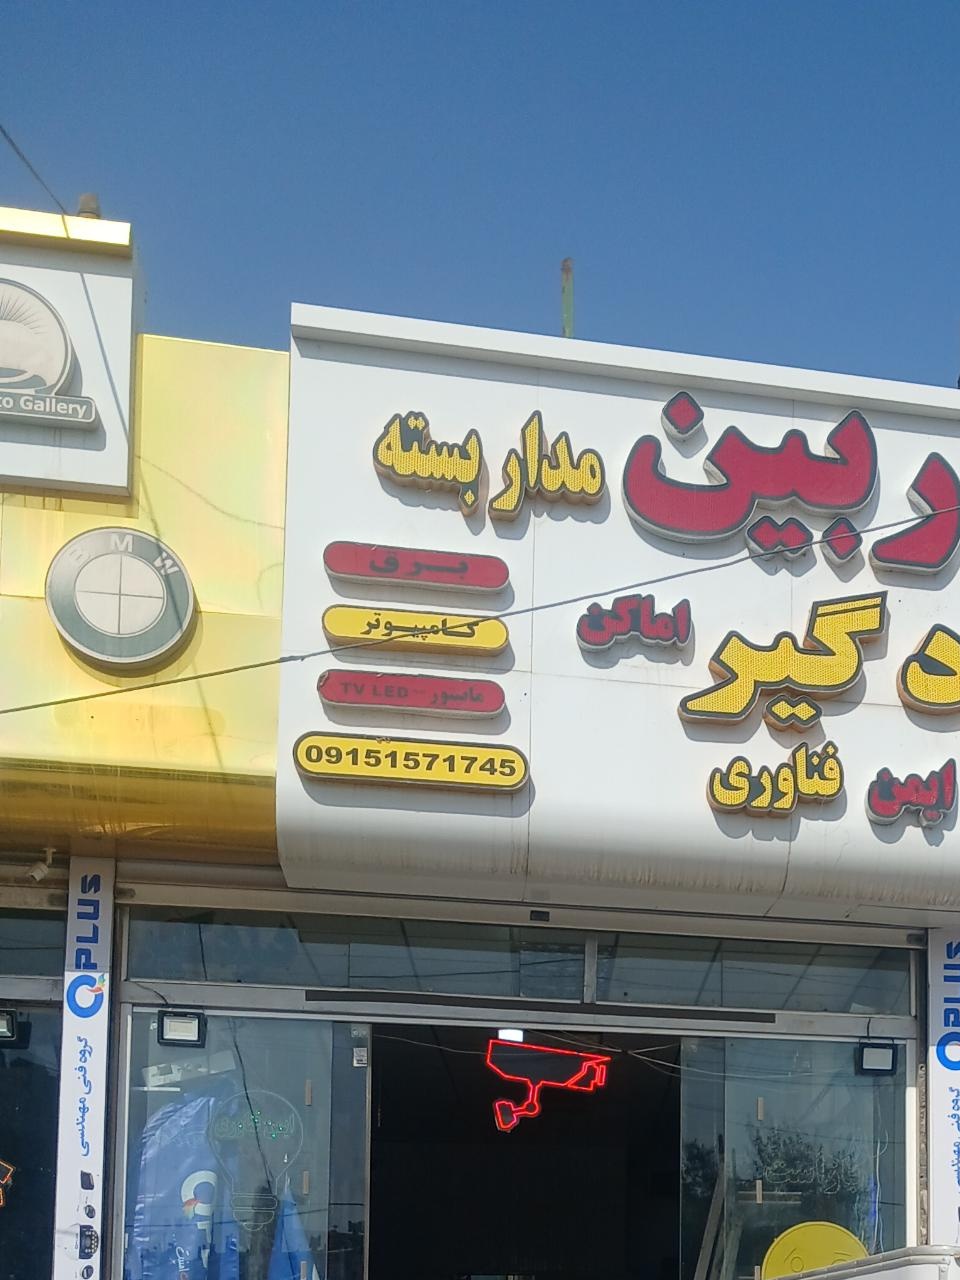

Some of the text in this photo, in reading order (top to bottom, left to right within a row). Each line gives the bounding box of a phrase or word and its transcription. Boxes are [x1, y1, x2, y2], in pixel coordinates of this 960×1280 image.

[20, 396, 87, 418] Gallery
[373, 410, 484, 512] بسته
[489, 410, 606, 518] مدار
[369, 552, 468, 579] برق
[360, 613, 479, 640] کامپیوتر
[576, 594, 691, 650] اماکن
[340, 682, 366, 696] TV
[372, 682, 409, 699] LED
[305, 744, 516, 777] 09151571745
[708, 741, 956, 826] ایمن فناوری
